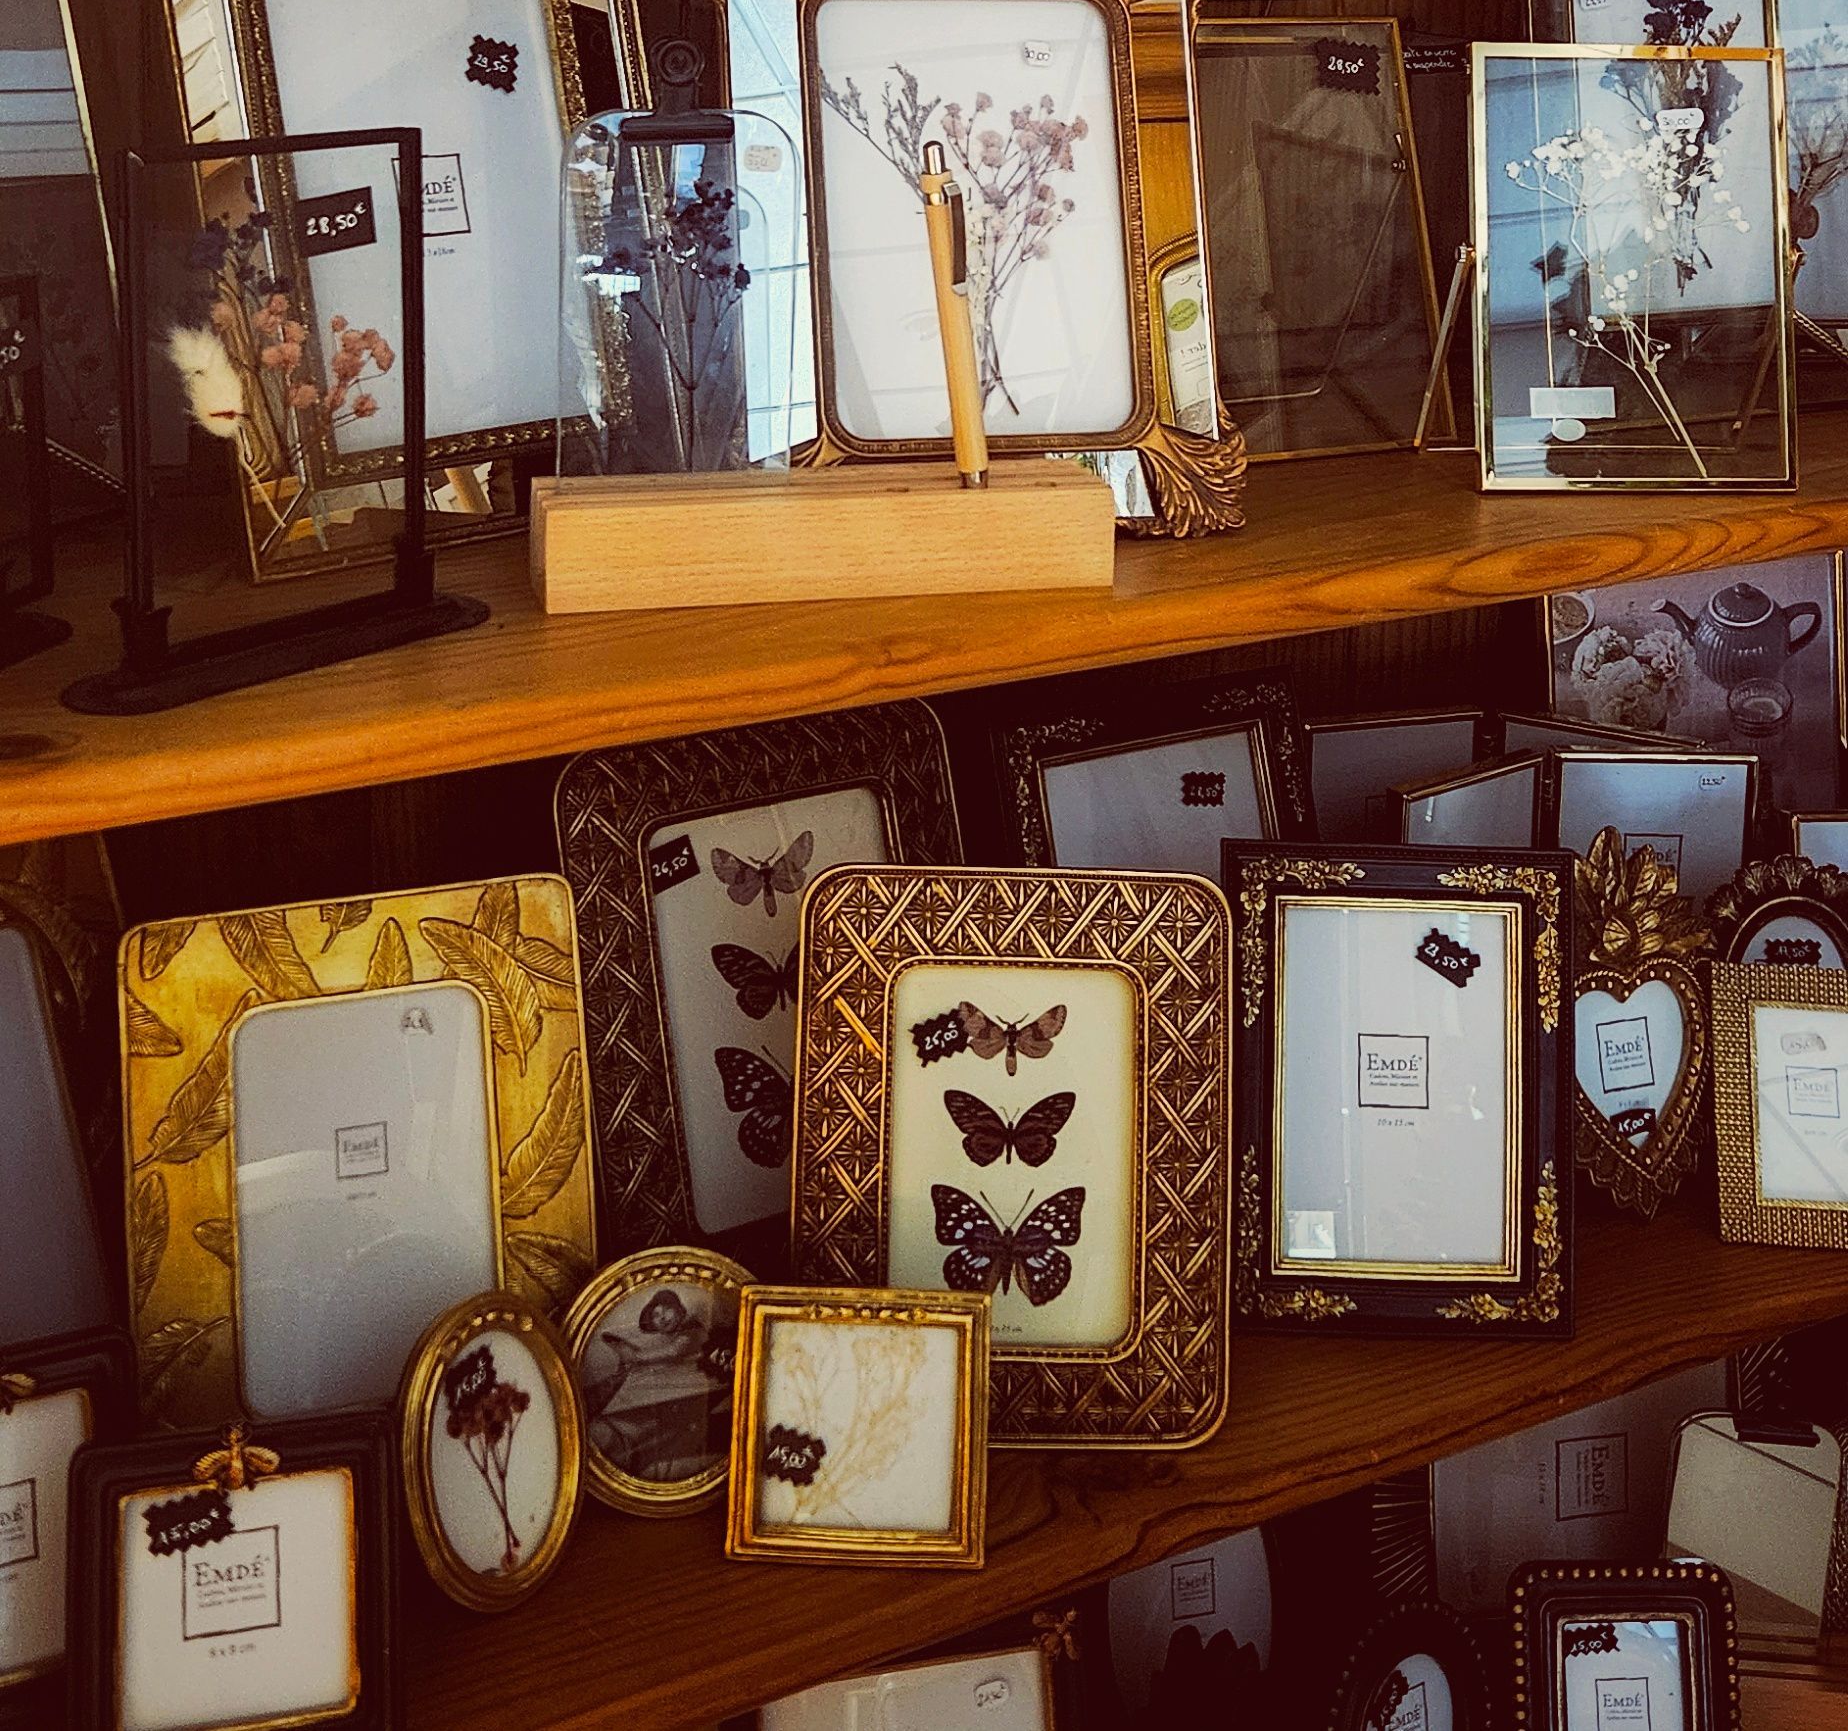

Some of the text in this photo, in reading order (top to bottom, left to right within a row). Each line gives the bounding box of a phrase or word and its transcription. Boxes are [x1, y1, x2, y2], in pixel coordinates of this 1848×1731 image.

[305, 201, 367, 237] 28,50€
[652, 846, 691, 877] 26,50€
[1603, 1034, 1644, 1058] EMDÉ
[1366, 1053, 1420, 1072] EMDÉ
[1603, 1691, 1642, 1708] EMDÉ
